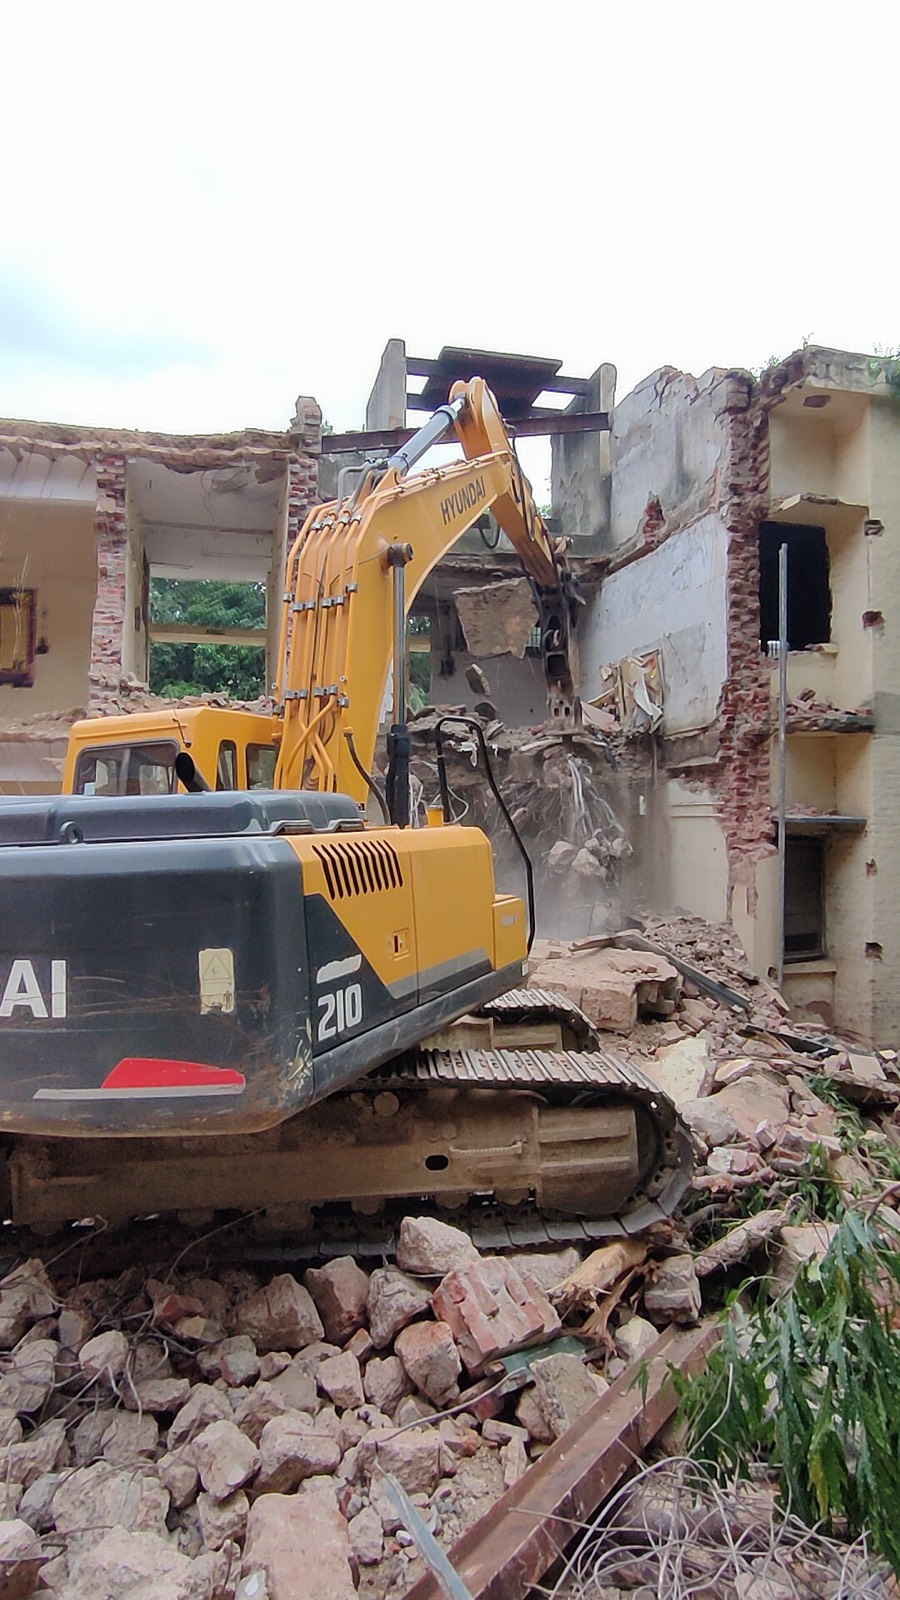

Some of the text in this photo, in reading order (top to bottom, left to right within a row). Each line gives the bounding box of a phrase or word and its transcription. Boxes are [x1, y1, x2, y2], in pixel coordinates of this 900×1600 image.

[440, 475, 486, 525] HYUNDAI
[0, 959, 66, 1018] AI
[317, 983, 363, 1042] 210
